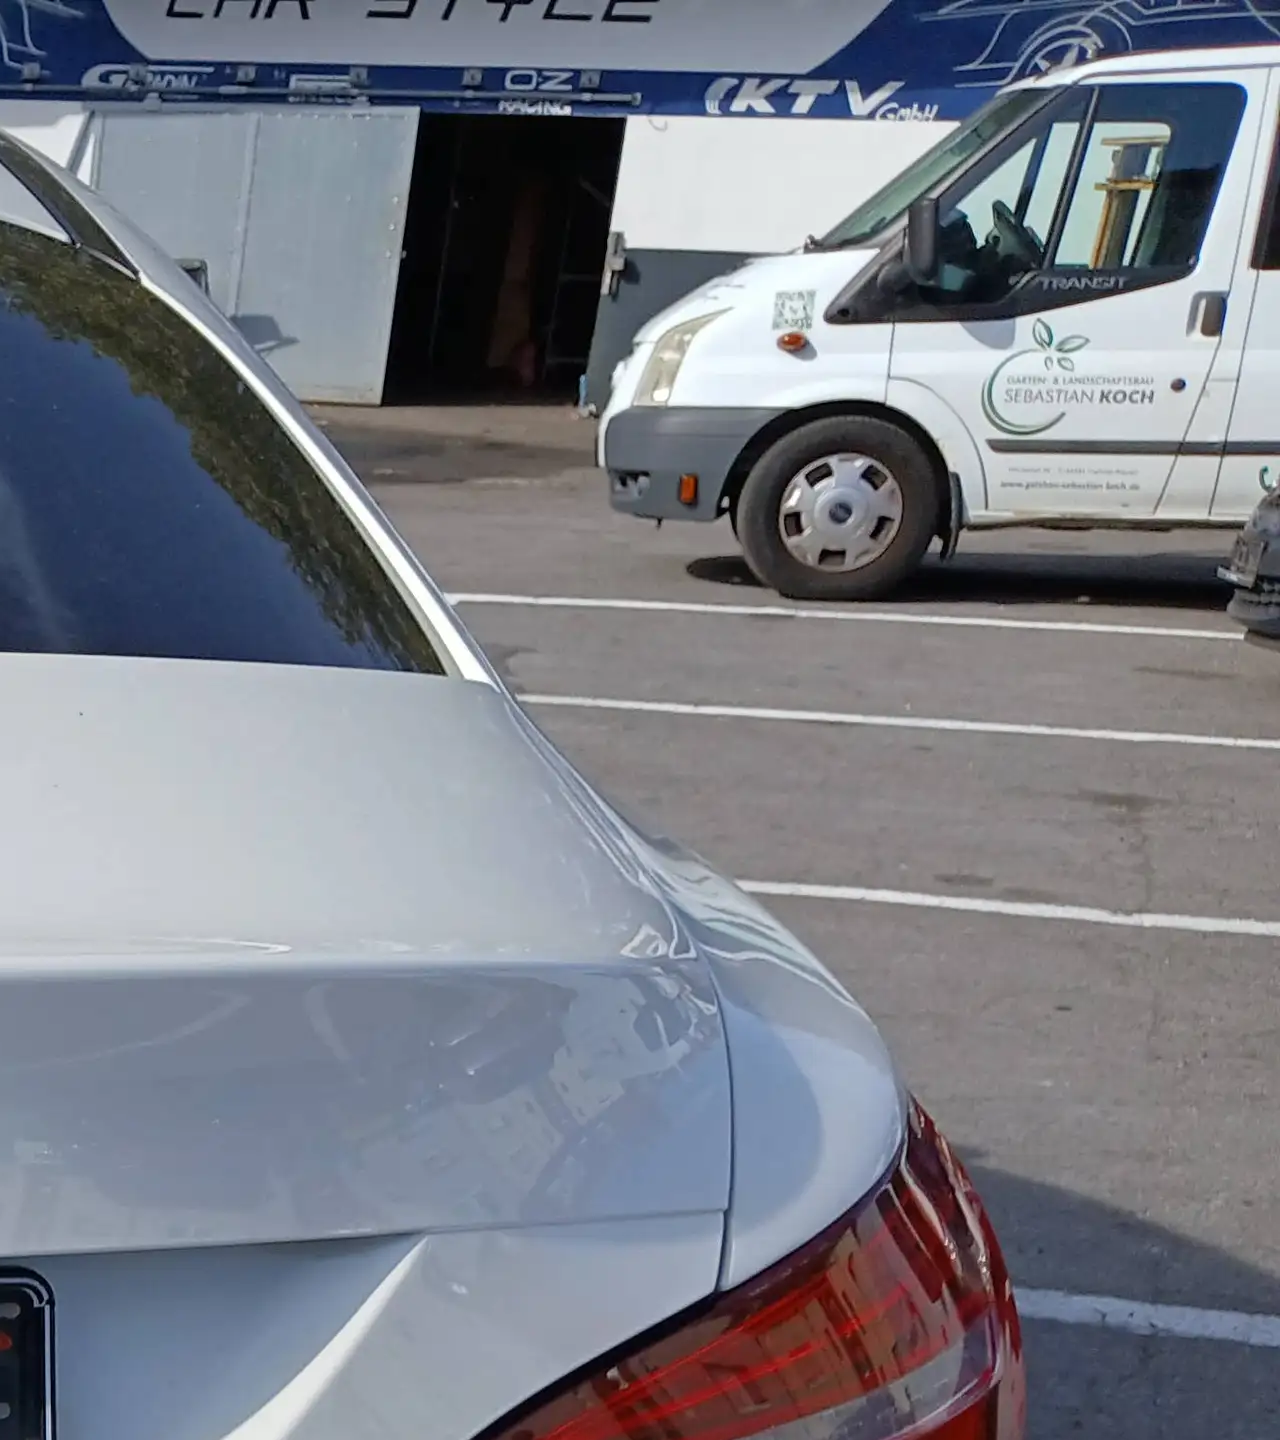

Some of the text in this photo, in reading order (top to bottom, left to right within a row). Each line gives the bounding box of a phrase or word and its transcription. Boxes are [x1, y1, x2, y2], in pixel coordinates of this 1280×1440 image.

[729, 77, 906, 116] KTV
[875, 102, 939, 122] GmbH
[1041, 275, 1128, 290] TRANSIT
[1062, 376, 1155, 386] LANDSCHAFTSBAU
[1004, 388, 1156, 405] SEBASTIAN KOCH
